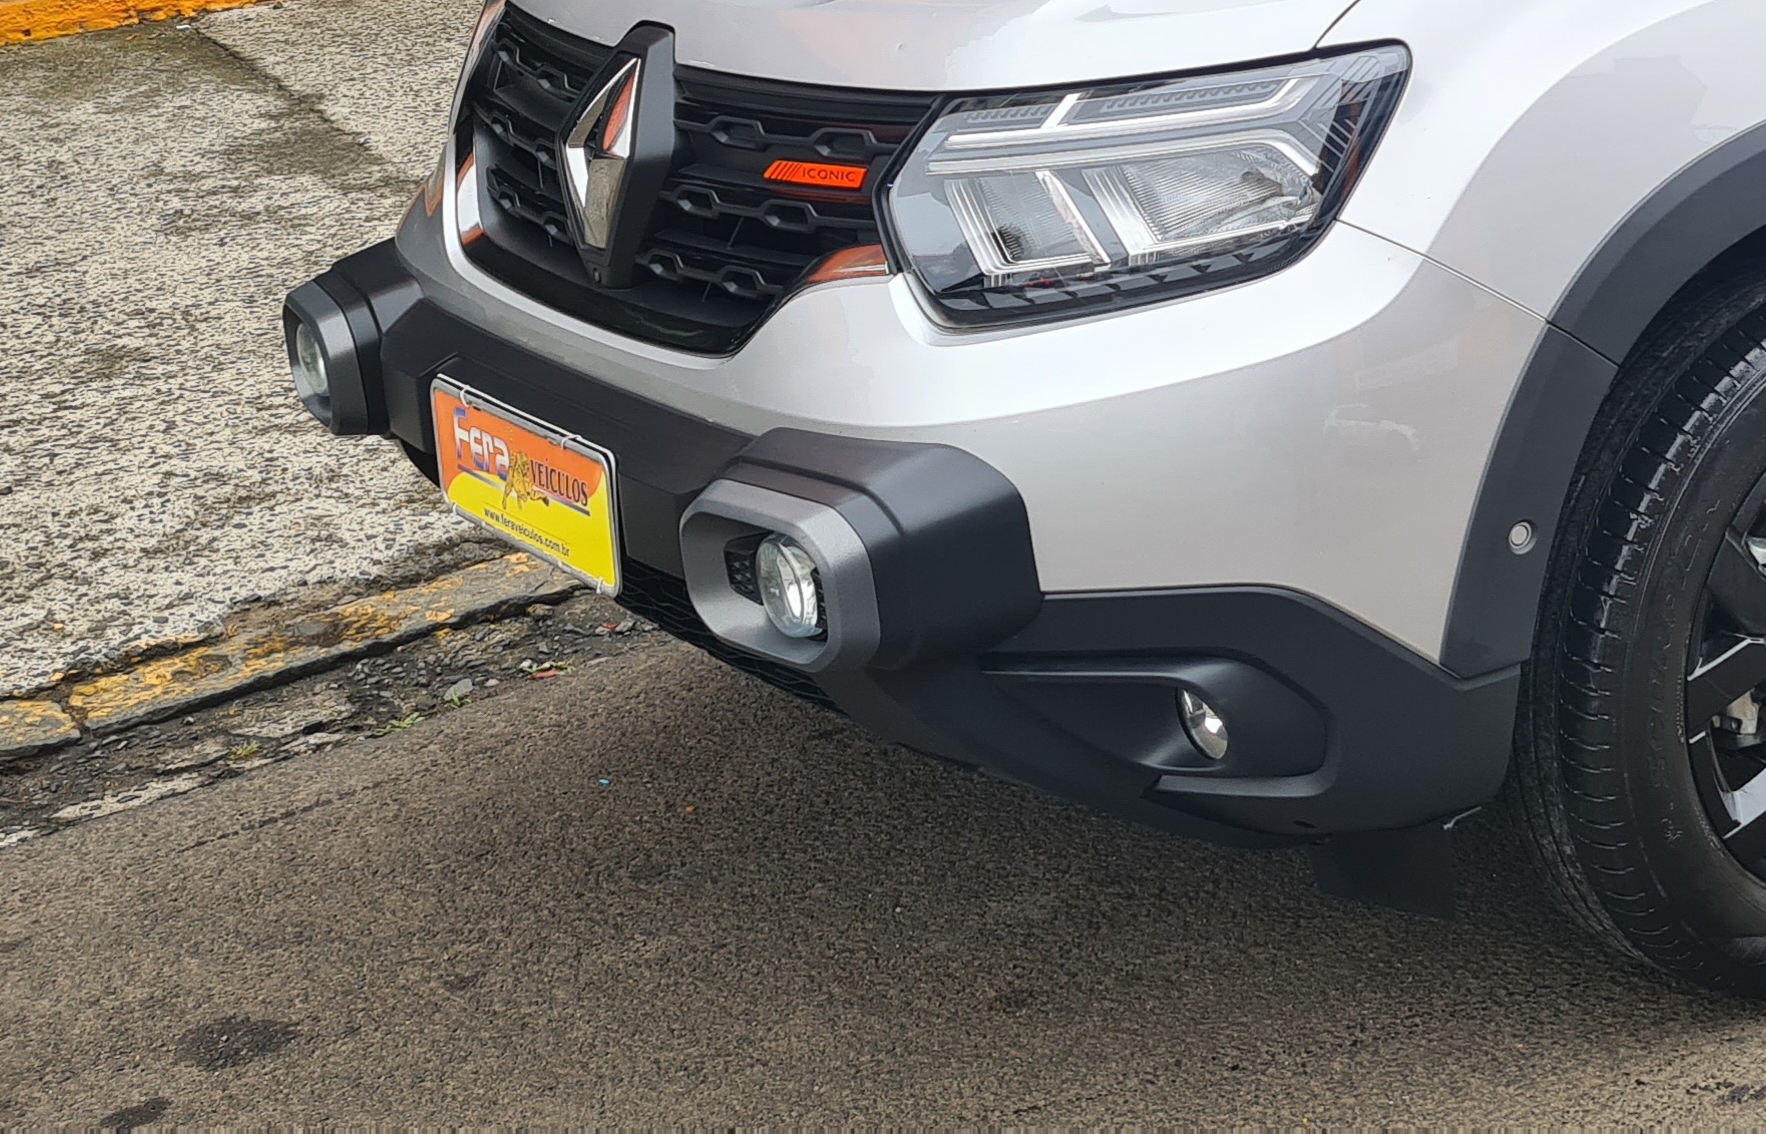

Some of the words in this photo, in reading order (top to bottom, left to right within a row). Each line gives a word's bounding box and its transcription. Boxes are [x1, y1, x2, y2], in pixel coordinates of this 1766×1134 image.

[802, 167, 856, 182] ICONIC
[453, 406, 511, 481] Fera
[529, 457, 589, 507] VEÍCULOS
[484, 507, 570, 558] www.feraveiculos.com.br
